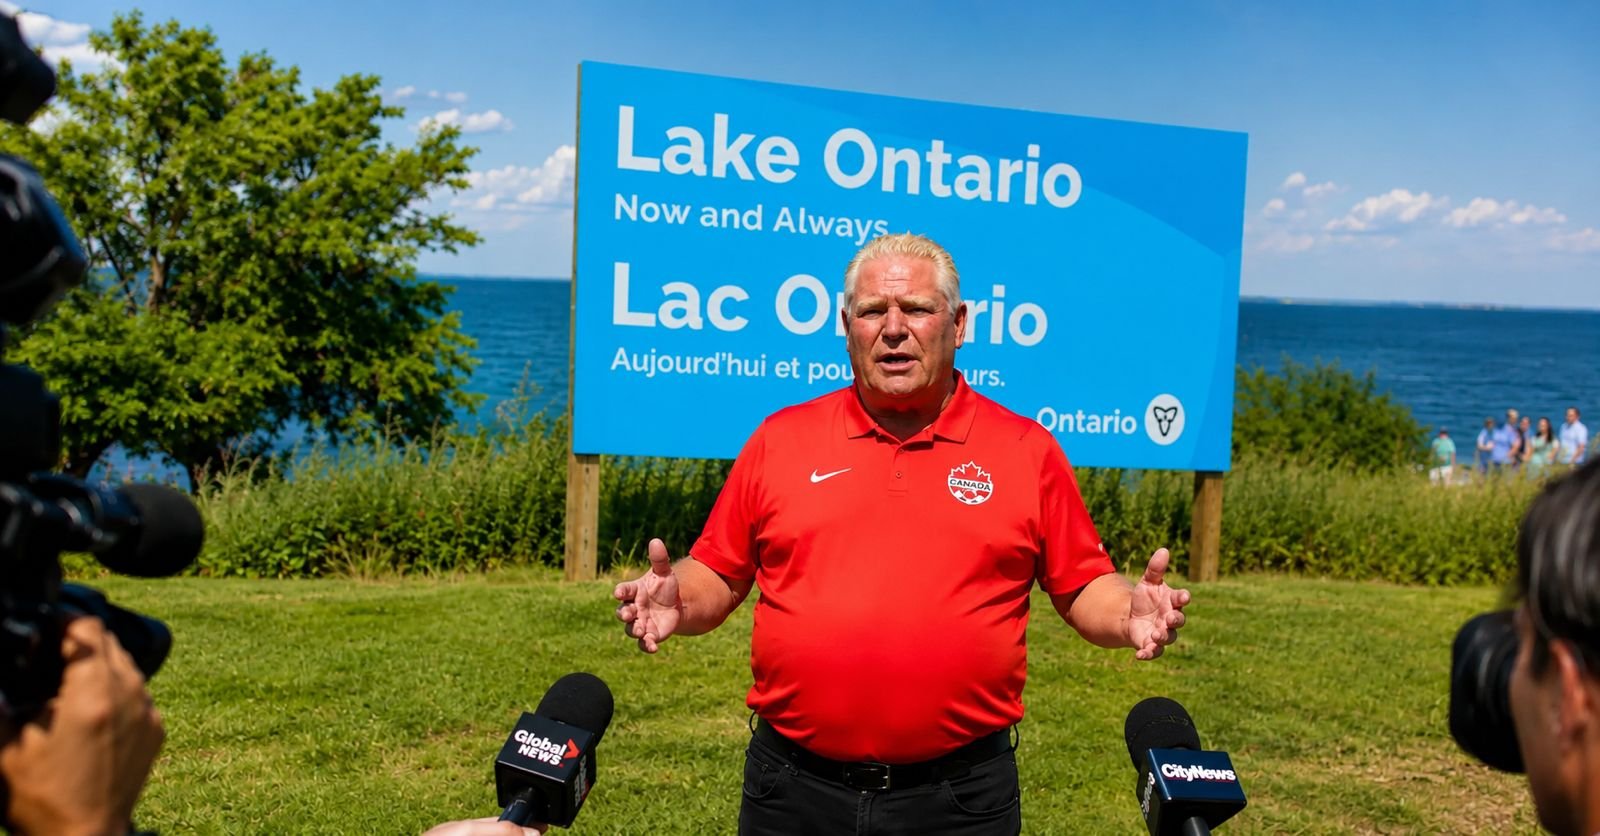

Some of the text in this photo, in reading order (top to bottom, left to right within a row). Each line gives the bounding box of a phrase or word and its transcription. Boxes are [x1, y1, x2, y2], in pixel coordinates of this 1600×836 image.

[617, 105, 1082, 209] Lake Ontario
[614, 193, 889, 247] Now and Always
[612, 261, 1048, 347] Lac Orio
[610, 347, 855, 385] Aujourd'hui et pou
[1036, 406, 1138, 435] Ontario
[949, 478, 991, 492] CANADA
[514, 729, 568, 757] Global
[1161, 763, 1236, 782] CityNews
